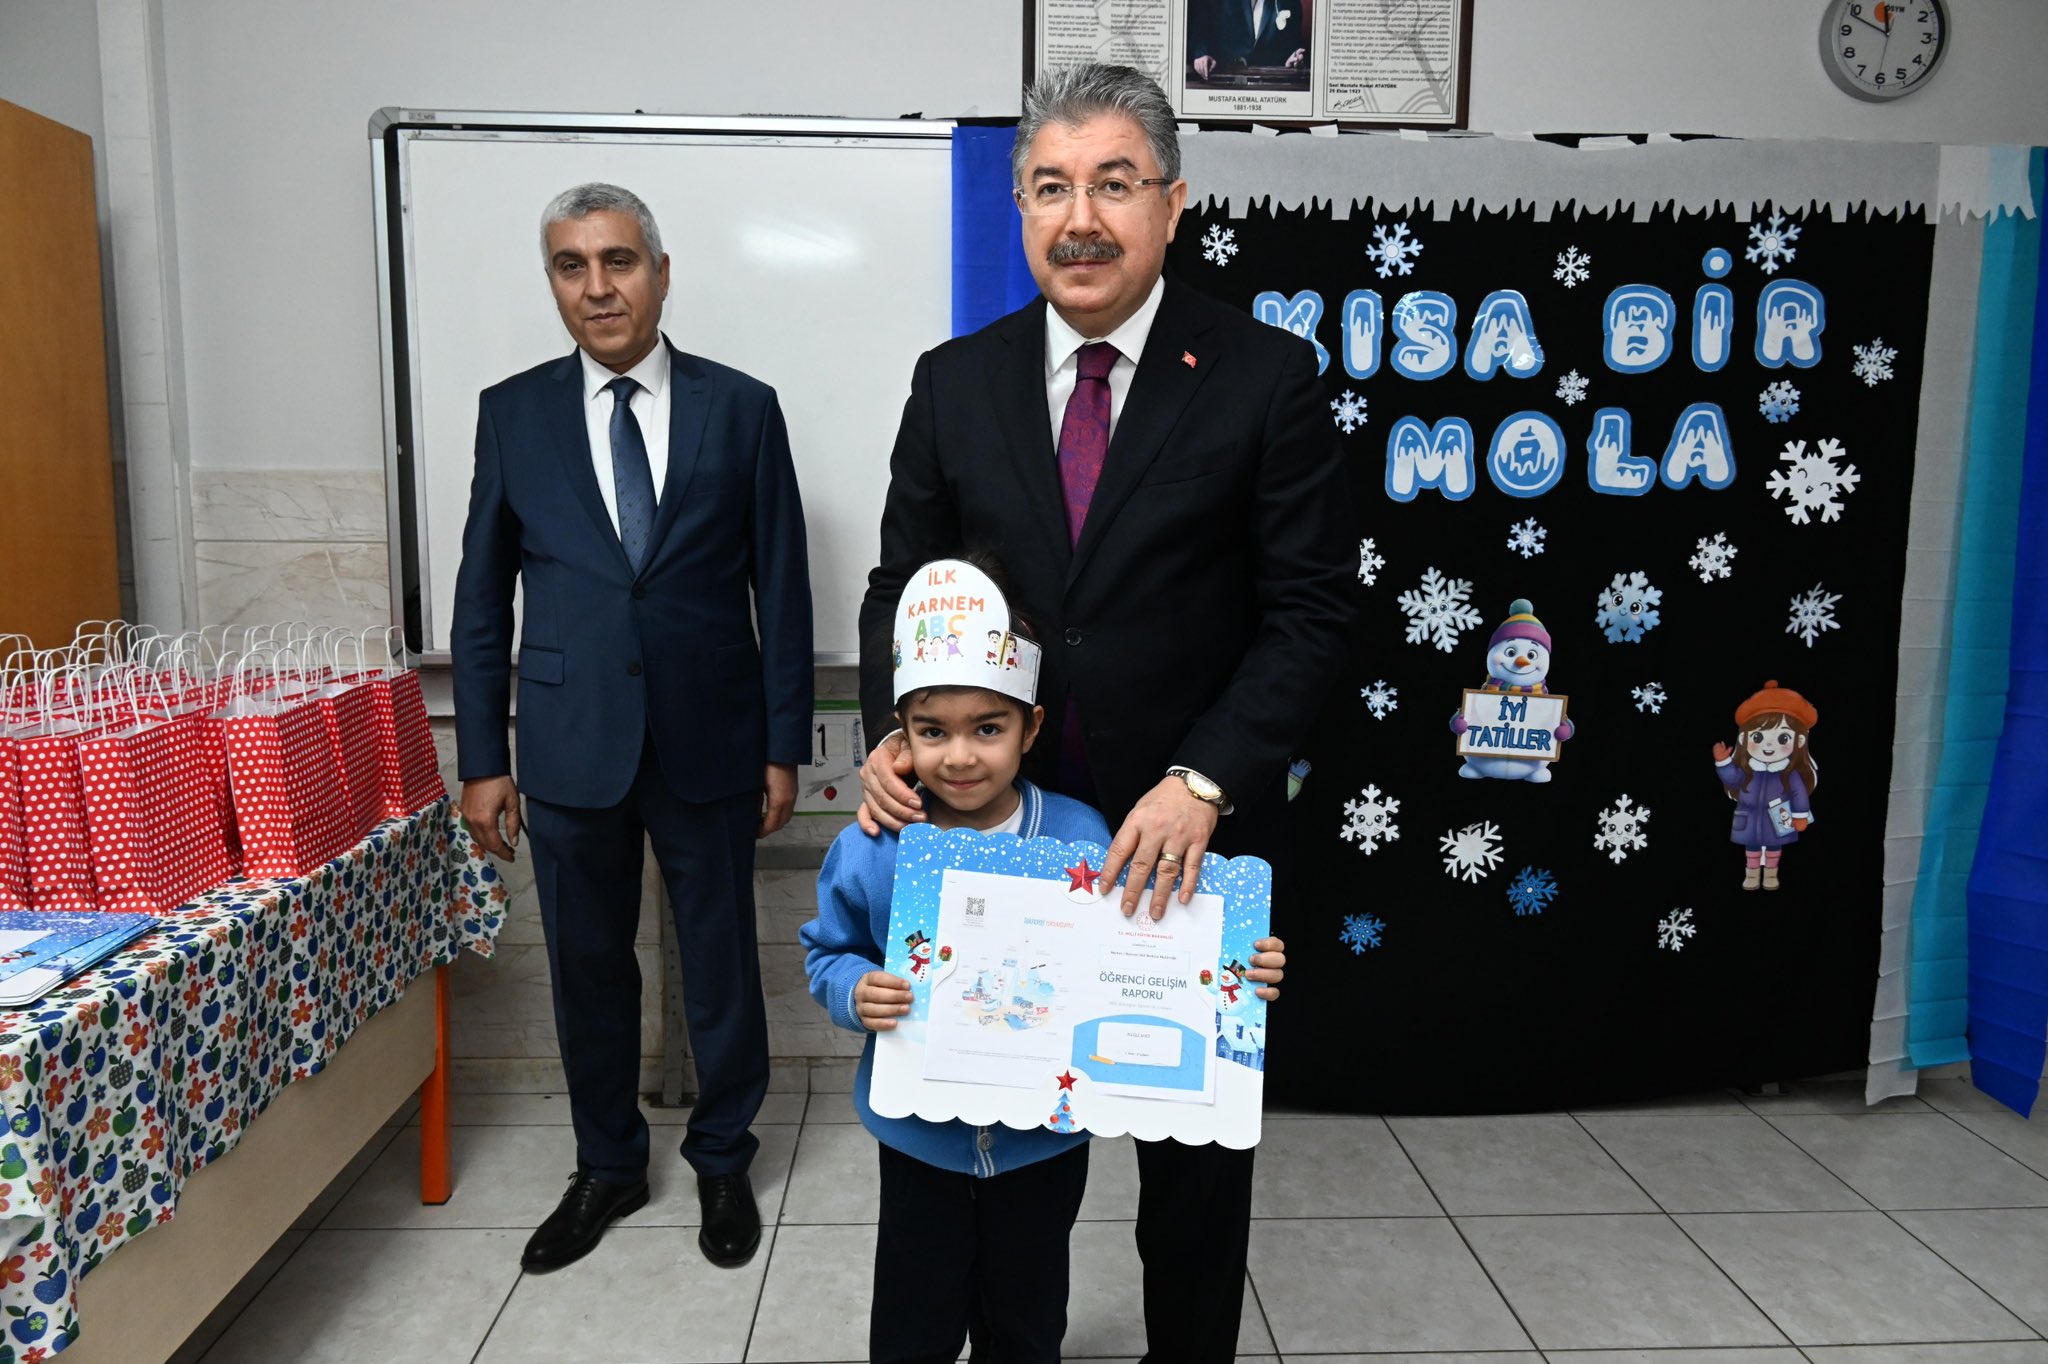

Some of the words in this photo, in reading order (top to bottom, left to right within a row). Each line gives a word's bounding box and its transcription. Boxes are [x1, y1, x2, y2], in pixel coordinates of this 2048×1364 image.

[1917, 11, 1929, 23] 2
[1841, 25, 1852, 36] 9
[1920, 33, 1932, 44] 3
[1843, 47, 1855, 58] 8
[1912, 54, 1922, 66] 4
[1857, 64, 1866, 76] 7
[1895, 68, 1907, 80] 5
[1875, 72, 1885, 84] 6
[1208, 95, 1237, 103] MUSTAFA
[1259, 95, 1287, 104] ATATÜRK
[1602, 247, 1826, 373] BİR
[1384, 402, 1737, 503] MOLA
[928, 568, 957, 586] İLK
[907, 596, 985, 619] KARNEM
[914, 613, 967, 641] ABC
[1498, 695, 1528, 722] İYİ
[1467, 722, 1551, 751] TATİLLER
[814, 759, 826, 768] bir
[1099, 970, 1146, 986] ÖĞRENCİ
[1147, 976, 1187, 990] GELİŞİM
[1121, 988, 1163, 1000] RAPORU
